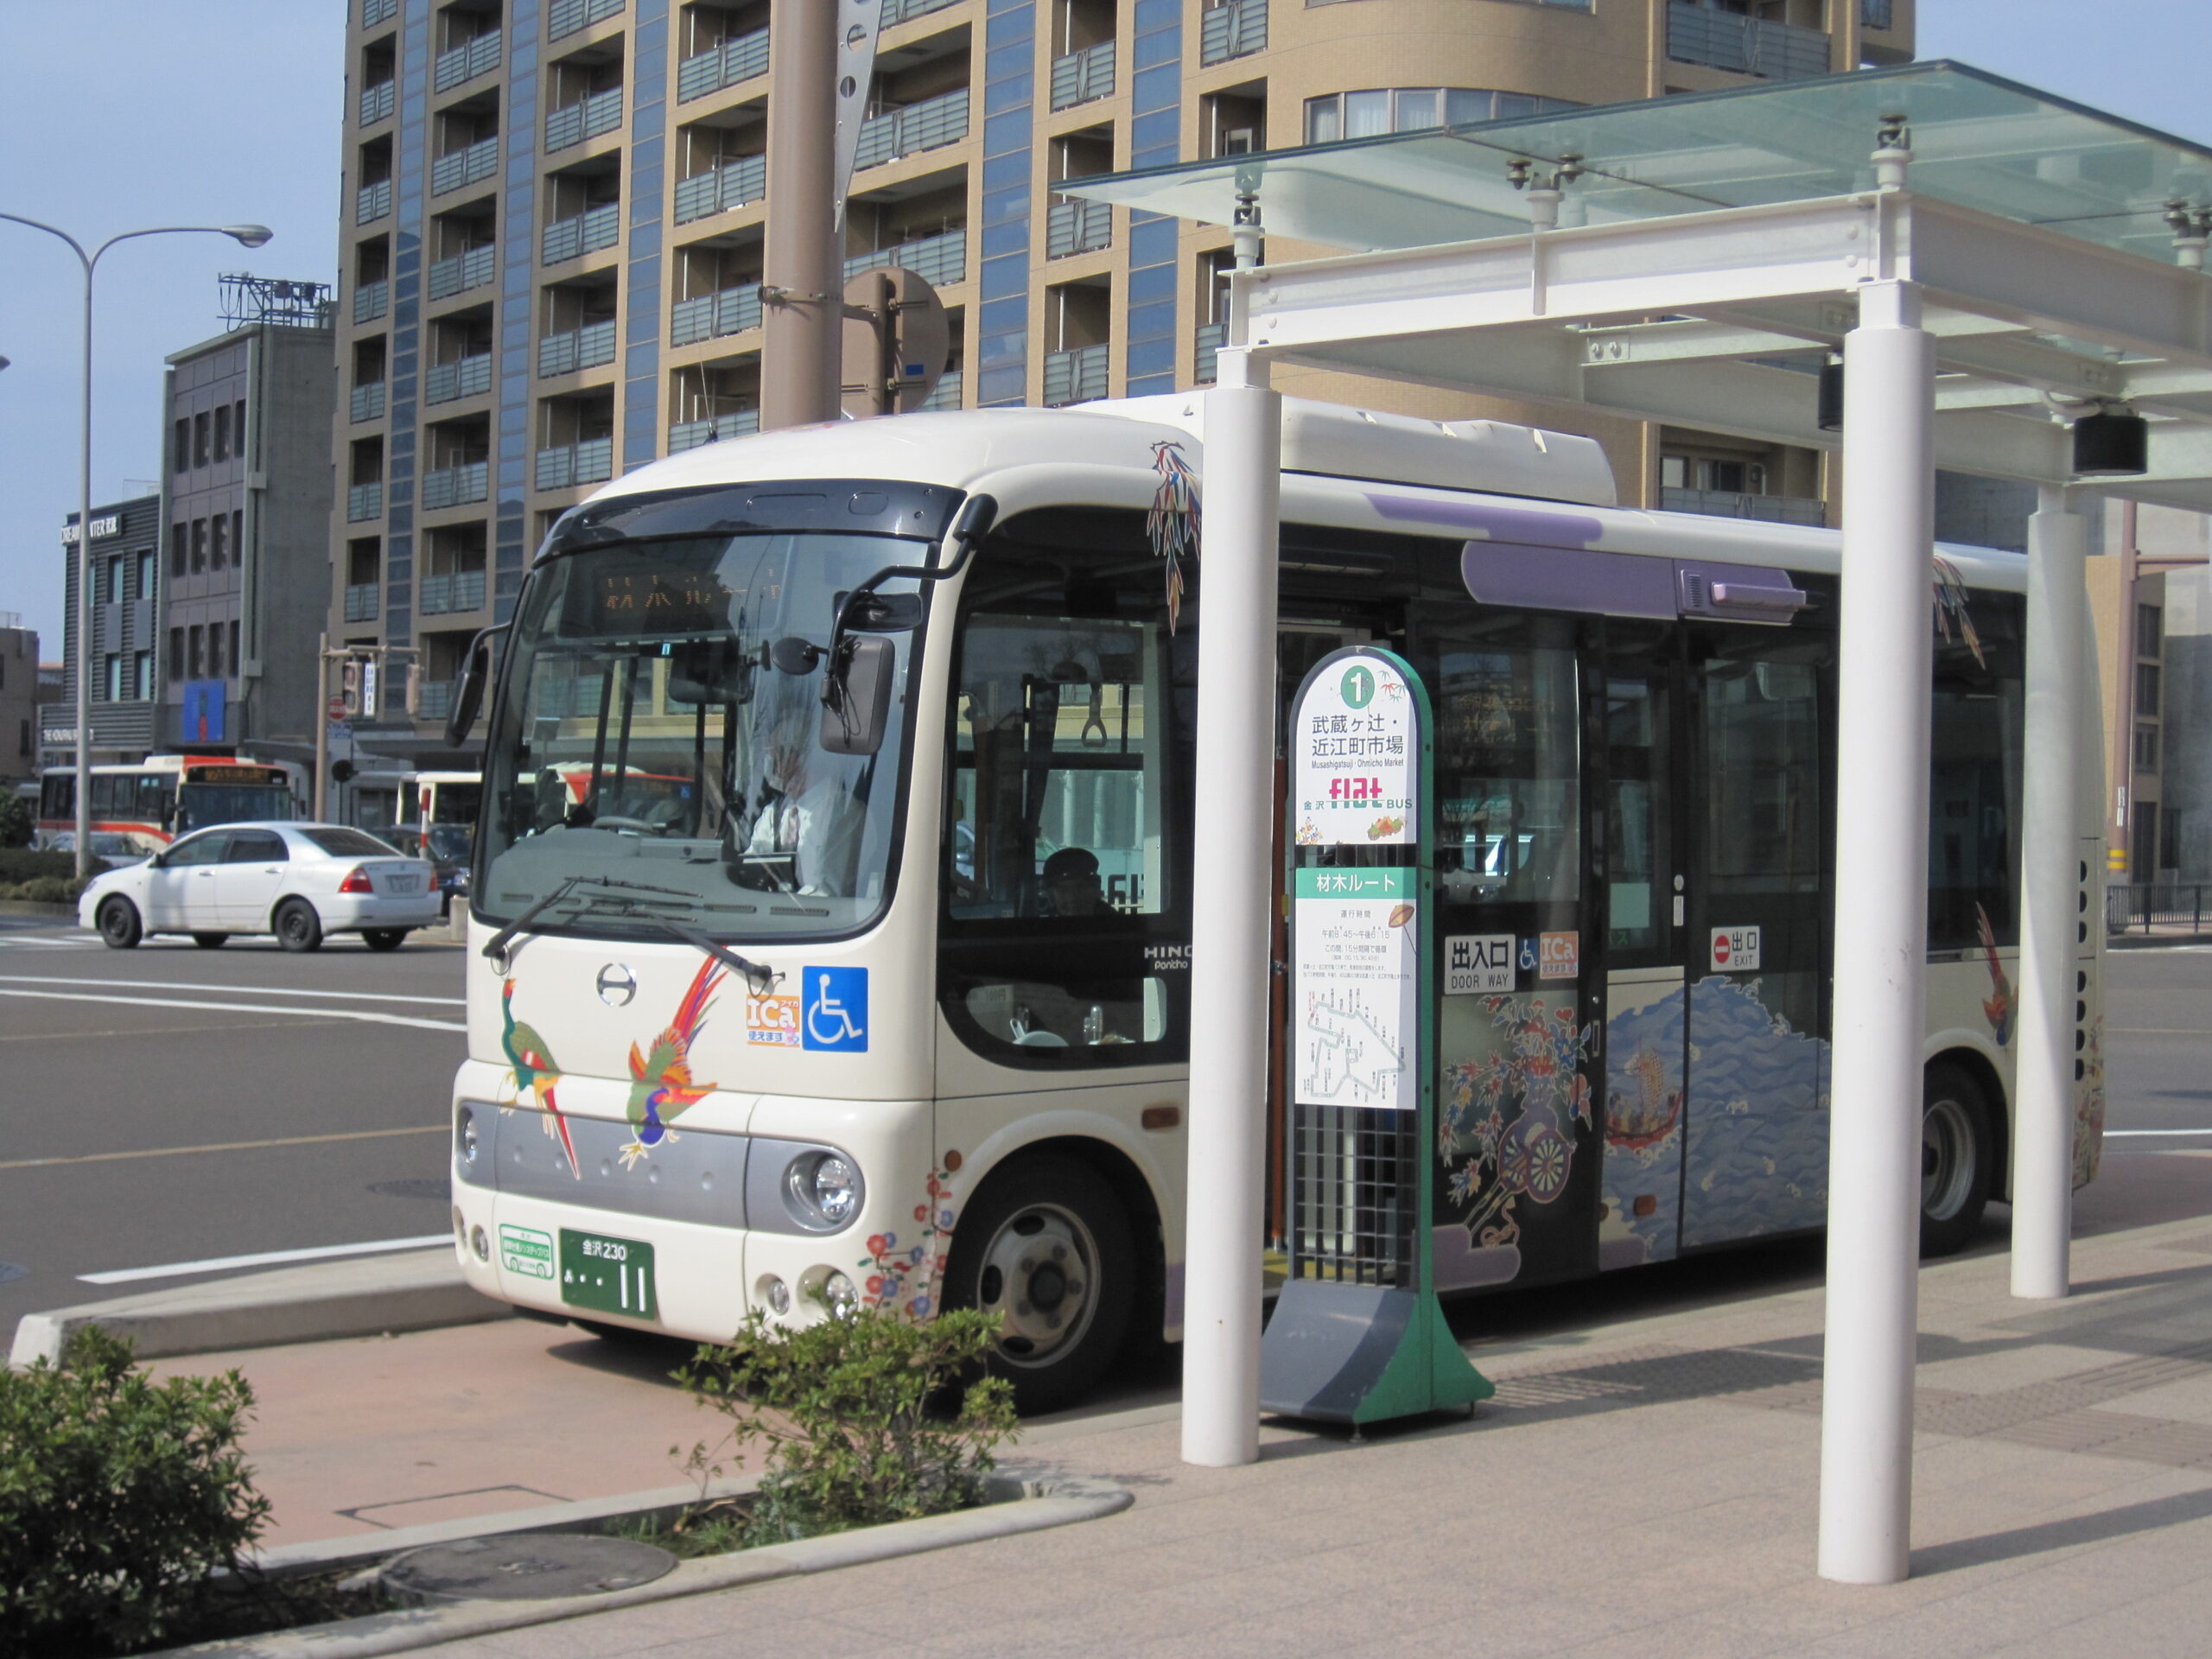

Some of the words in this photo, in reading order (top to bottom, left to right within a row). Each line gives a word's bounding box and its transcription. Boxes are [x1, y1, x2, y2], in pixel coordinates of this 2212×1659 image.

[1350, 671, 1363, 702] 1
[1313, 735, 1403, 756] 近江町市場
[1384, 759, 1404, 767] Market
[1304, 800, 1325, 810] 金沢
[1386, 798, 1413, 810] BUS
[1316, 874, 1395, 892] 材木ルート
[1541, 938, 1573, 961] ICa
[1732, 931, 1757, 951] 出口
[1452, 940, 1509, 970] 出入口
[1734, 955, 1753, 967] EXIT
[1452, 975, 1480, 988] DOOR
[1488, 974, 1509, 988] WAY
[747, 998, 796, 1029] ICa
